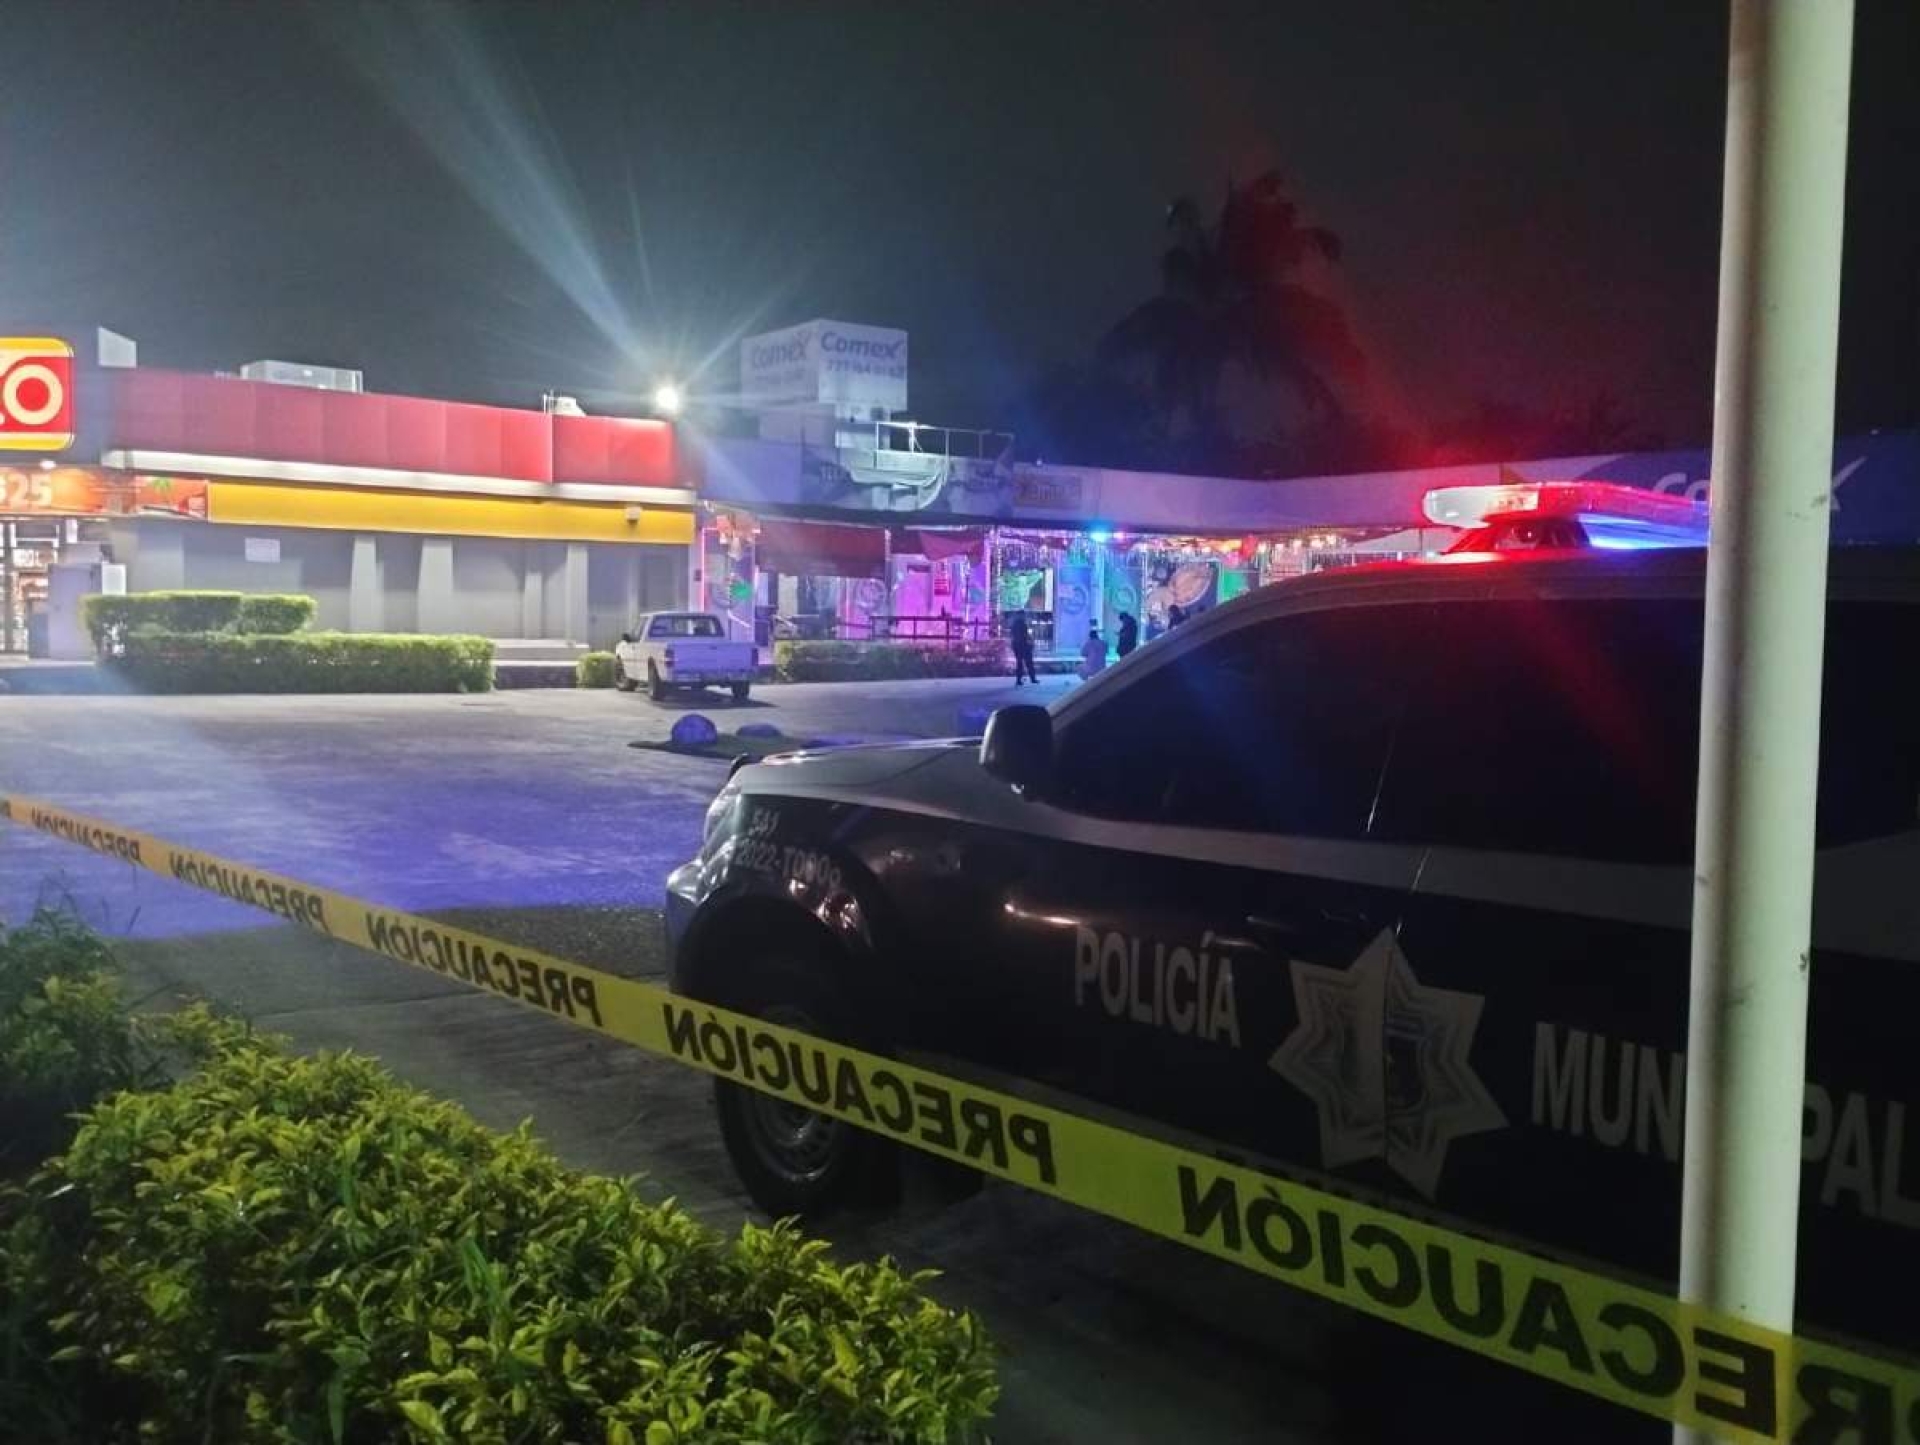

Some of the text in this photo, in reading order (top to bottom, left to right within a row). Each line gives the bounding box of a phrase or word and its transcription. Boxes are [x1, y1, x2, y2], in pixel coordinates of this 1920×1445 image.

[820, 331, 905, 359] Comex
[1074, 924, 1920, 1230] POLICÍA MUNPAL
